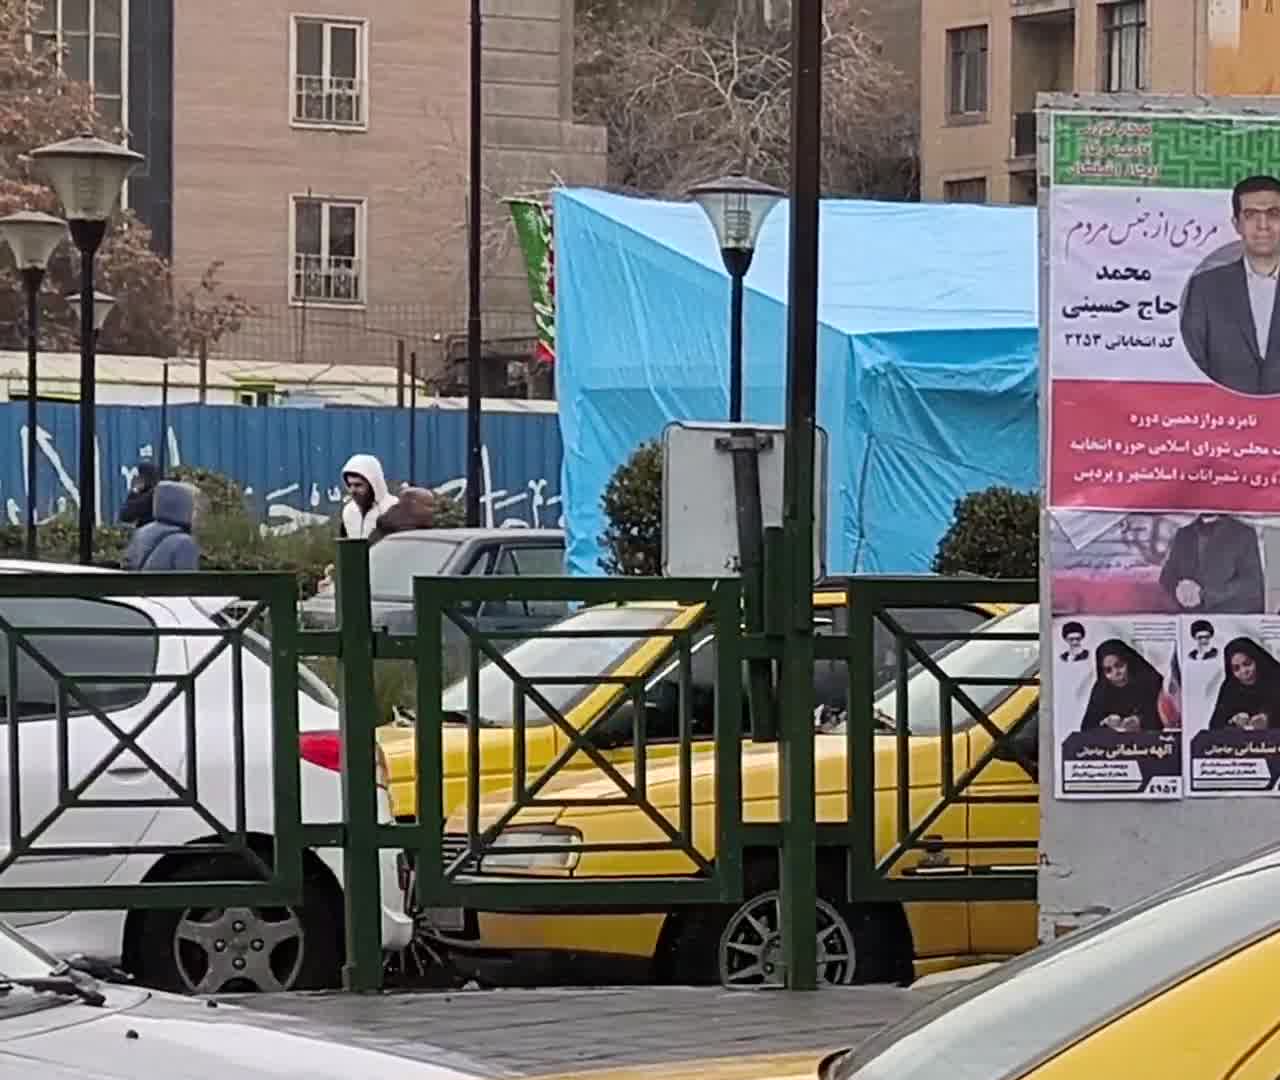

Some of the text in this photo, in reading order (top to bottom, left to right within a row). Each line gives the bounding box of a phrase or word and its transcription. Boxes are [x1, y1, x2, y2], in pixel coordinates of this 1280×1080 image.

[1065, 196, 1217, 261] مردی از جنس مردم
[1096, 265, 1151, 280] محمد
[1062, 295, 1178, 320] حاج حسینی
[1105, 335, 1156, 350] انتخاباتی
[1158, 336, 1175, 348] کد
[1130, 412, 1257, 430] نامزد دوازدهمین دوره
[1070, 437, 1112, 451] انتخابیه
[1115, 441, 1146, 455] حوزه
[1148, 440, 1190, 455] اسلامی
[1192, 441, 1230, 457] شورای
[1232, 441, 1269, 457] مجلس
[1073, 468, 1113, 483] پردیس
[1128, 466, 1177, 483] اسلامشهر
